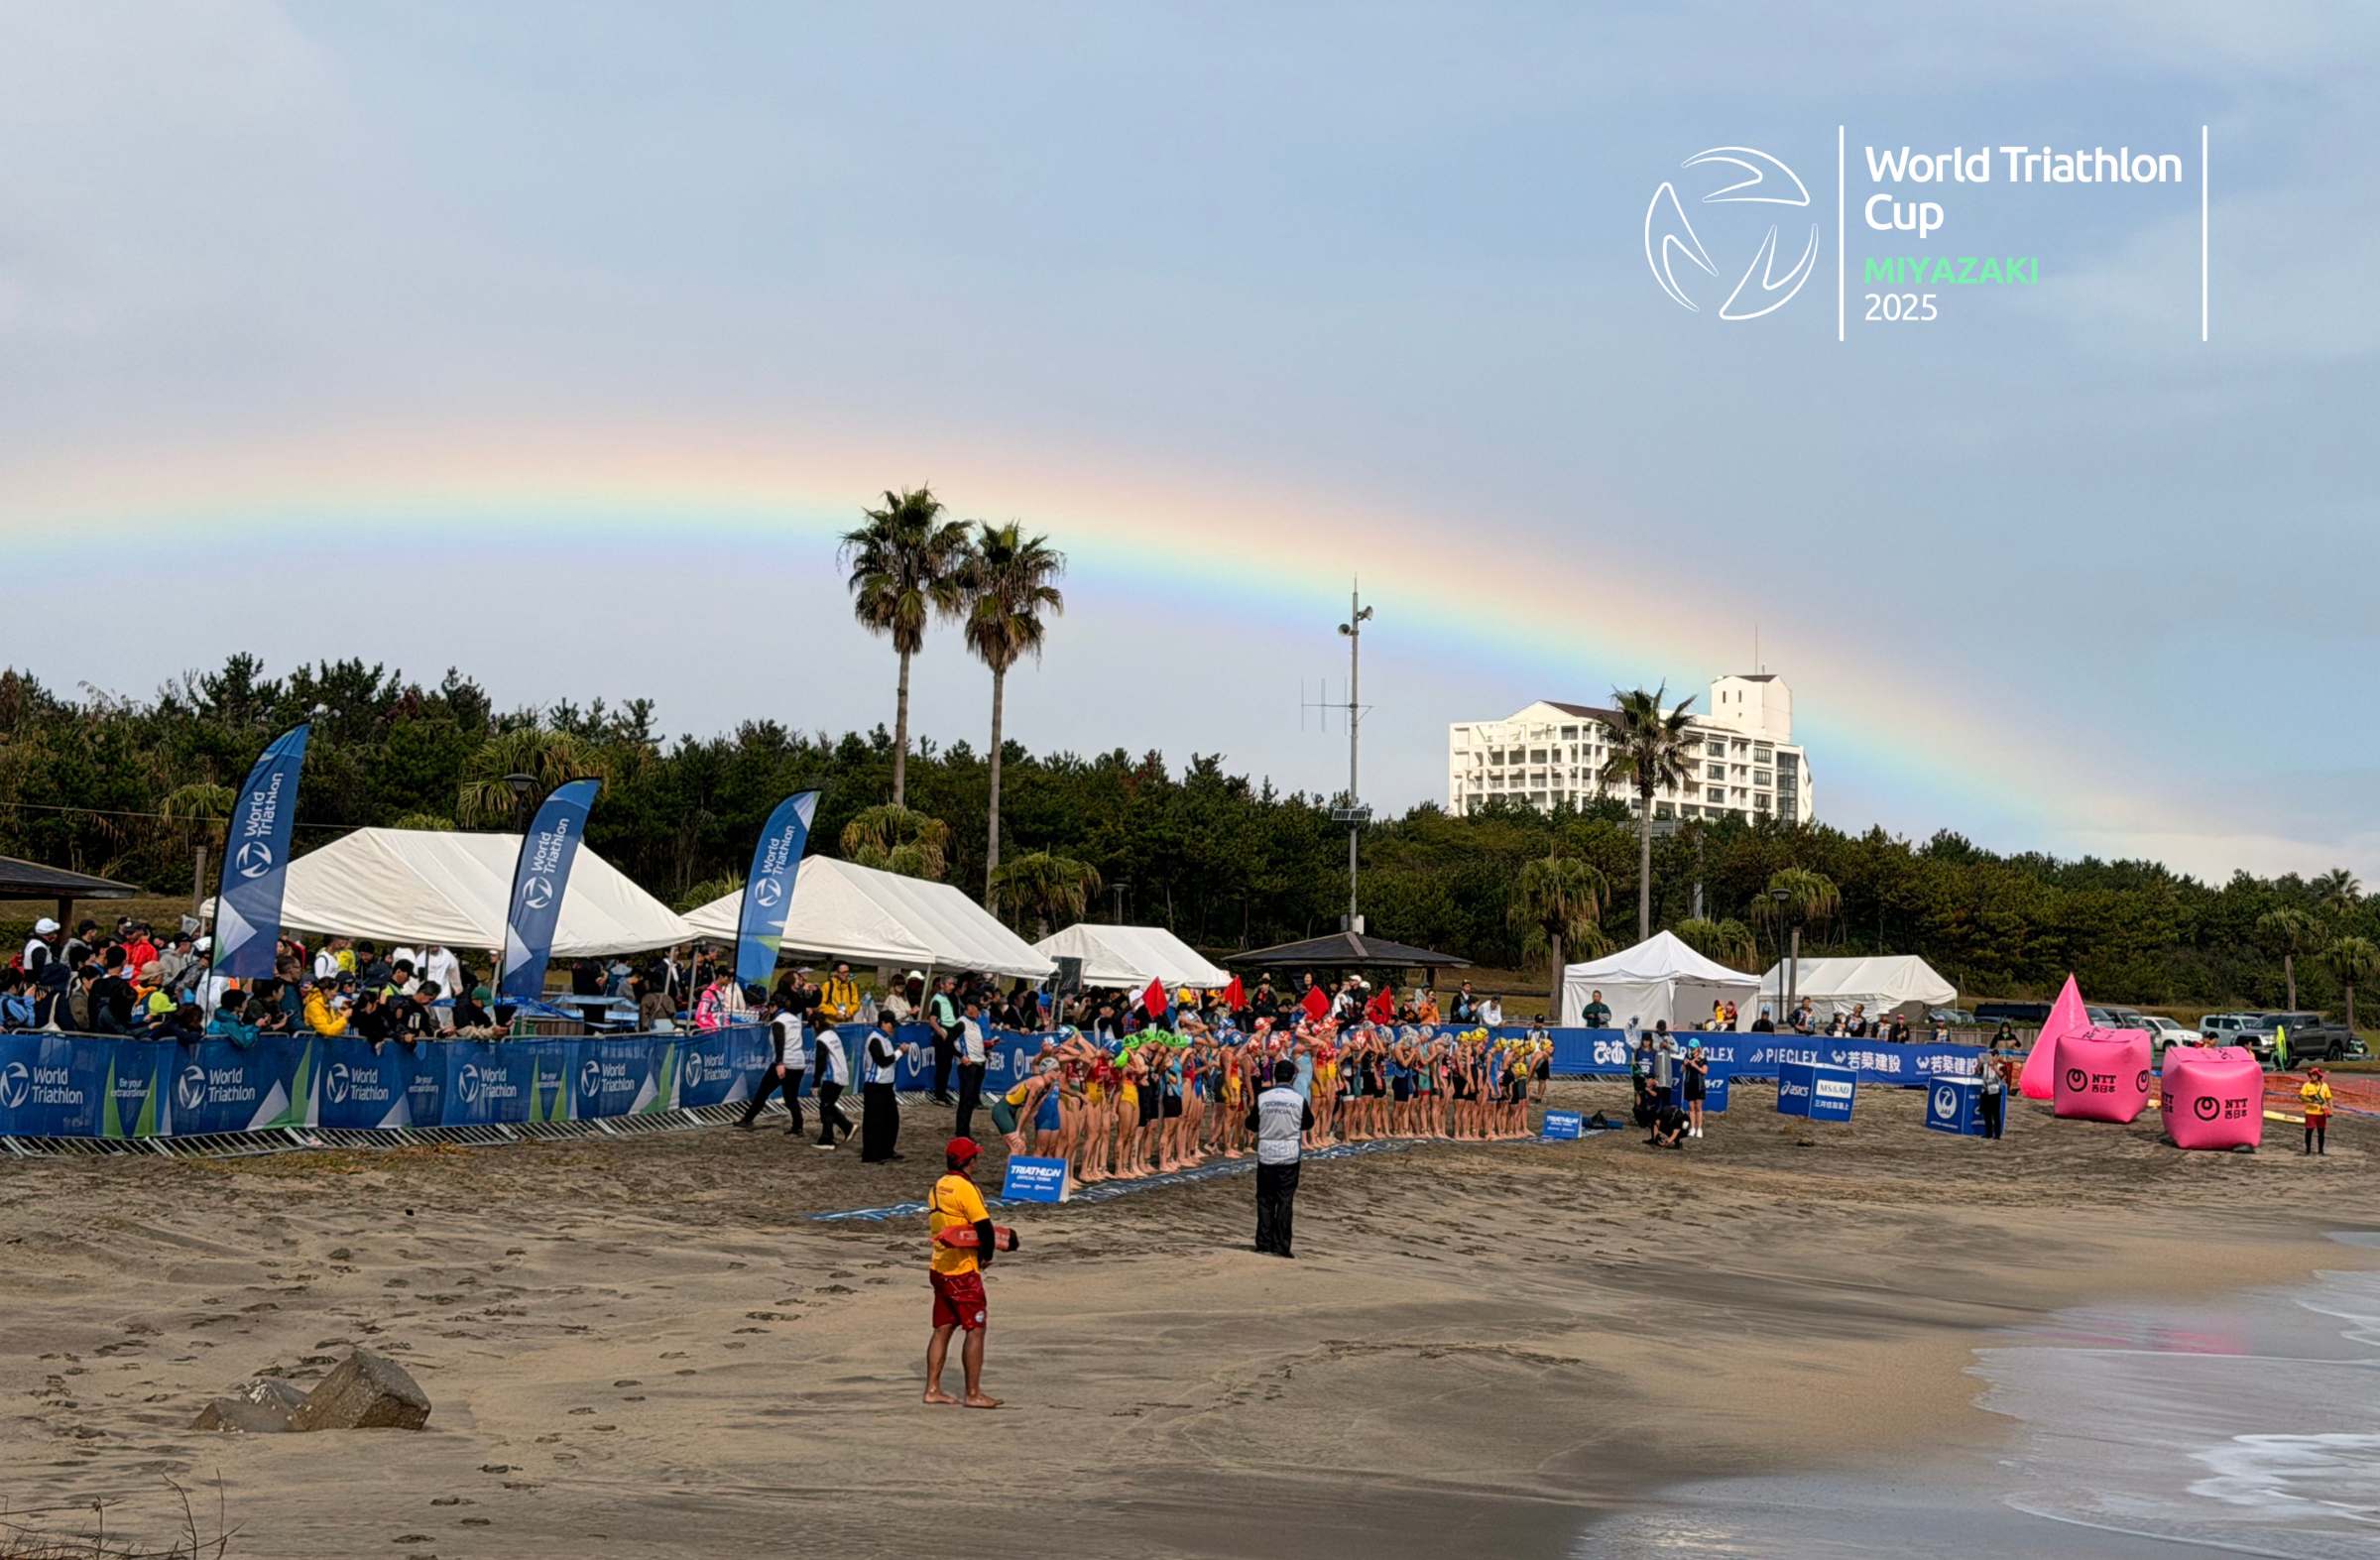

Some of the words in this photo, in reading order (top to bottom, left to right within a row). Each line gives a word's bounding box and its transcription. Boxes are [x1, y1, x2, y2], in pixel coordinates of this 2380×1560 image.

[258, 773, 284, 838] Triathlon
[244, 791, 266, 838] World
[532, 831, 550, 872] World
[543, 818, 569, 874] Triathlon
[773, 825, 796, 876] Triathlon
[762, 838, 778, 874] World
[704, 1053, 724, 1067] World
[1765, 1048, 1818, 1064] PIECLEX
[1847, 1051, 1901, 1073] 若築建設
[33, 1067, 68, 1086] World
[209, 1067, 243, 1085] World
[351, 1068, 378, 1084] World
[481, 1067, 507, 1082] World
[602, 1063, 626, 1078] World
[704, 1068, 732, 1081] Triathlon
[602, 1078, 635, 1092] Triathlon
[2092, 1074, 2116, 1084] NTT
[32, 1086, 83, 1105] Triathlon
[208, 1085, 255, 1103] Triathlon
[351, 1084, 389, 1101] Triathlon
[481, 1082, 517, 1098] Triathlon
[2091, 1084, 2116, 1093] 西日本
[2224, 1098, 2248, 1109] NTT
[2224, 1110, 2247, 1120] 西日本
[1012, 1165, 1061, 1177] TRIATHLON
